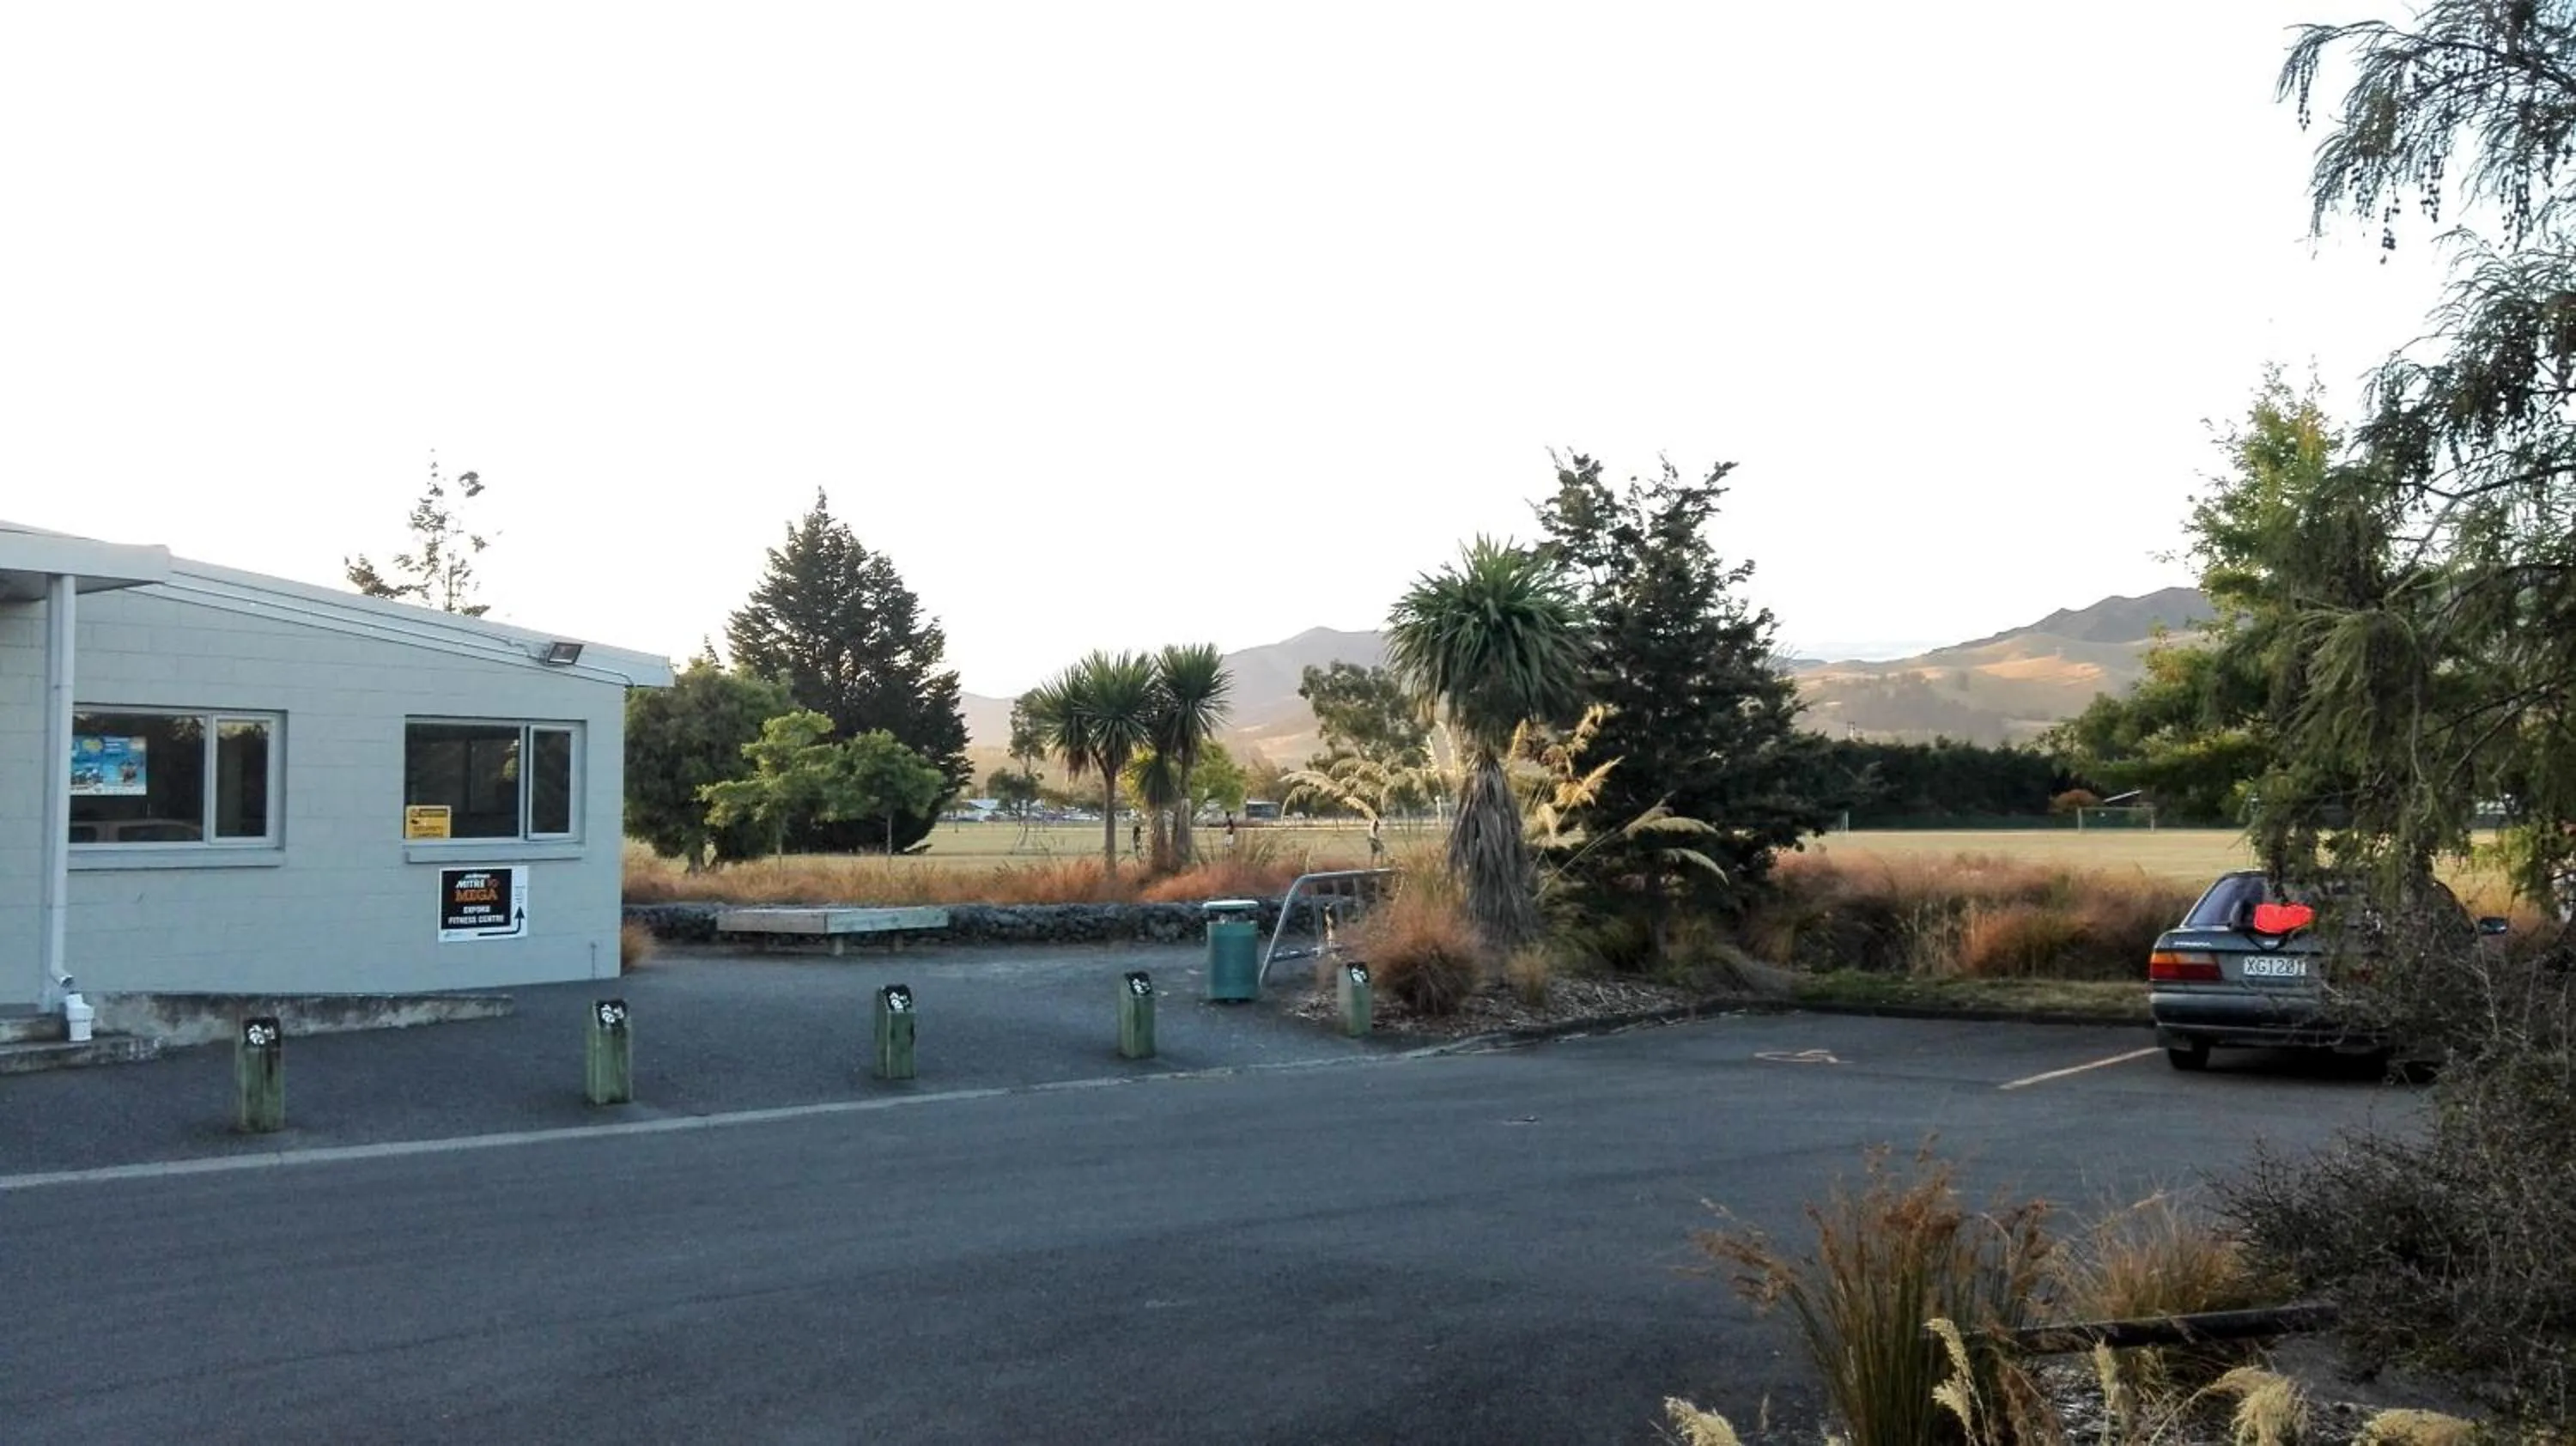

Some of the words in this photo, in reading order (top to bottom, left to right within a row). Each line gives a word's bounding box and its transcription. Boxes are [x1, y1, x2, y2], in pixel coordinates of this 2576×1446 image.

[456, 879, 485, 888] MITRE
[455, 889, 498, 902] MEGA
[478, 914, 504, 923] CENTRE
